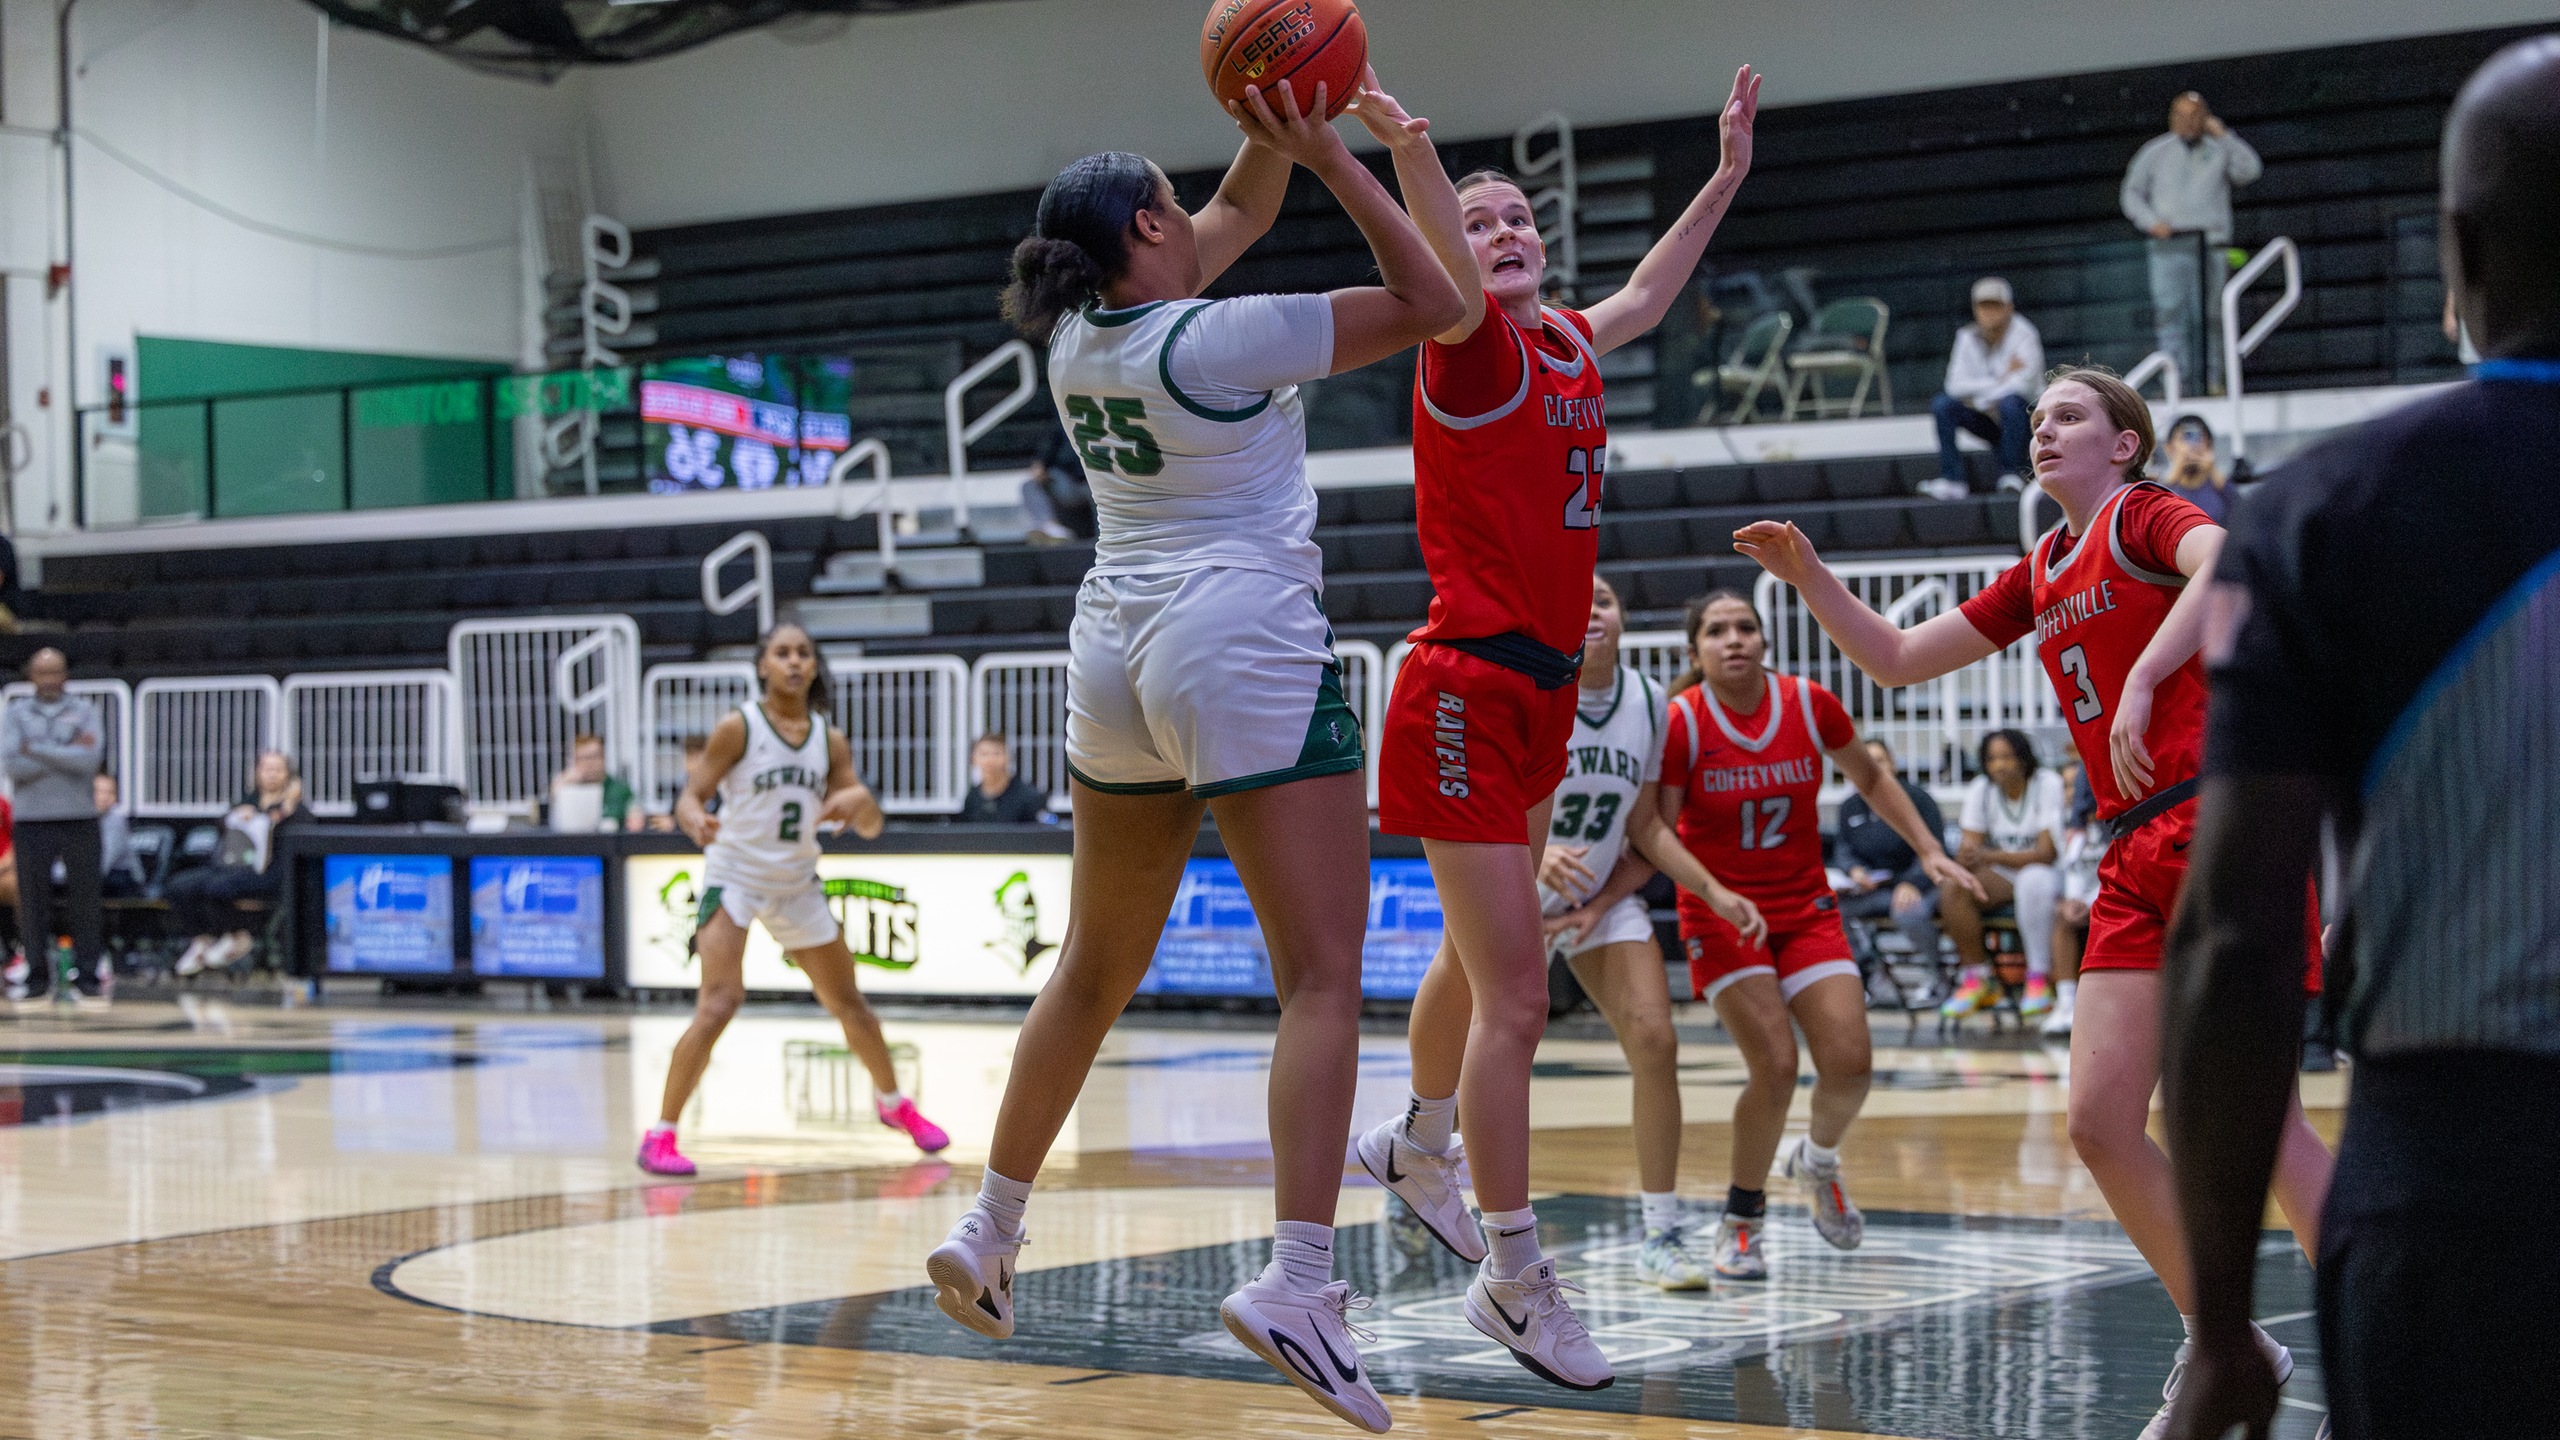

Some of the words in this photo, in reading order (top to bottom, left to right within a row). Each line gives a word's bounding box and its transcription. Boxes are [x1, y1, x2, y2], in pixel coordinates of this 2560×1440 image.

[1208, 0, 1250, 49] SPAL
[1231, 1, 1312, 75] LEGACY
[1266, 20, 1315, 63] 1000
[1065, 394, 1165, 476] 25
[2034, 579, 2117, 645] OFFEYVILLE
[2059, 642, 2103, 724] 3
[1435, 690, 1470, 800] RAVENS
[1566, 746, 1639, 788] WARD
[1703, 756, 1814, 793] COFFEYVILLE
[779, 801, 802, 842] 2
[1553, 793, 1622, 842] 33
[1740, 795, 1792, 851] 12
